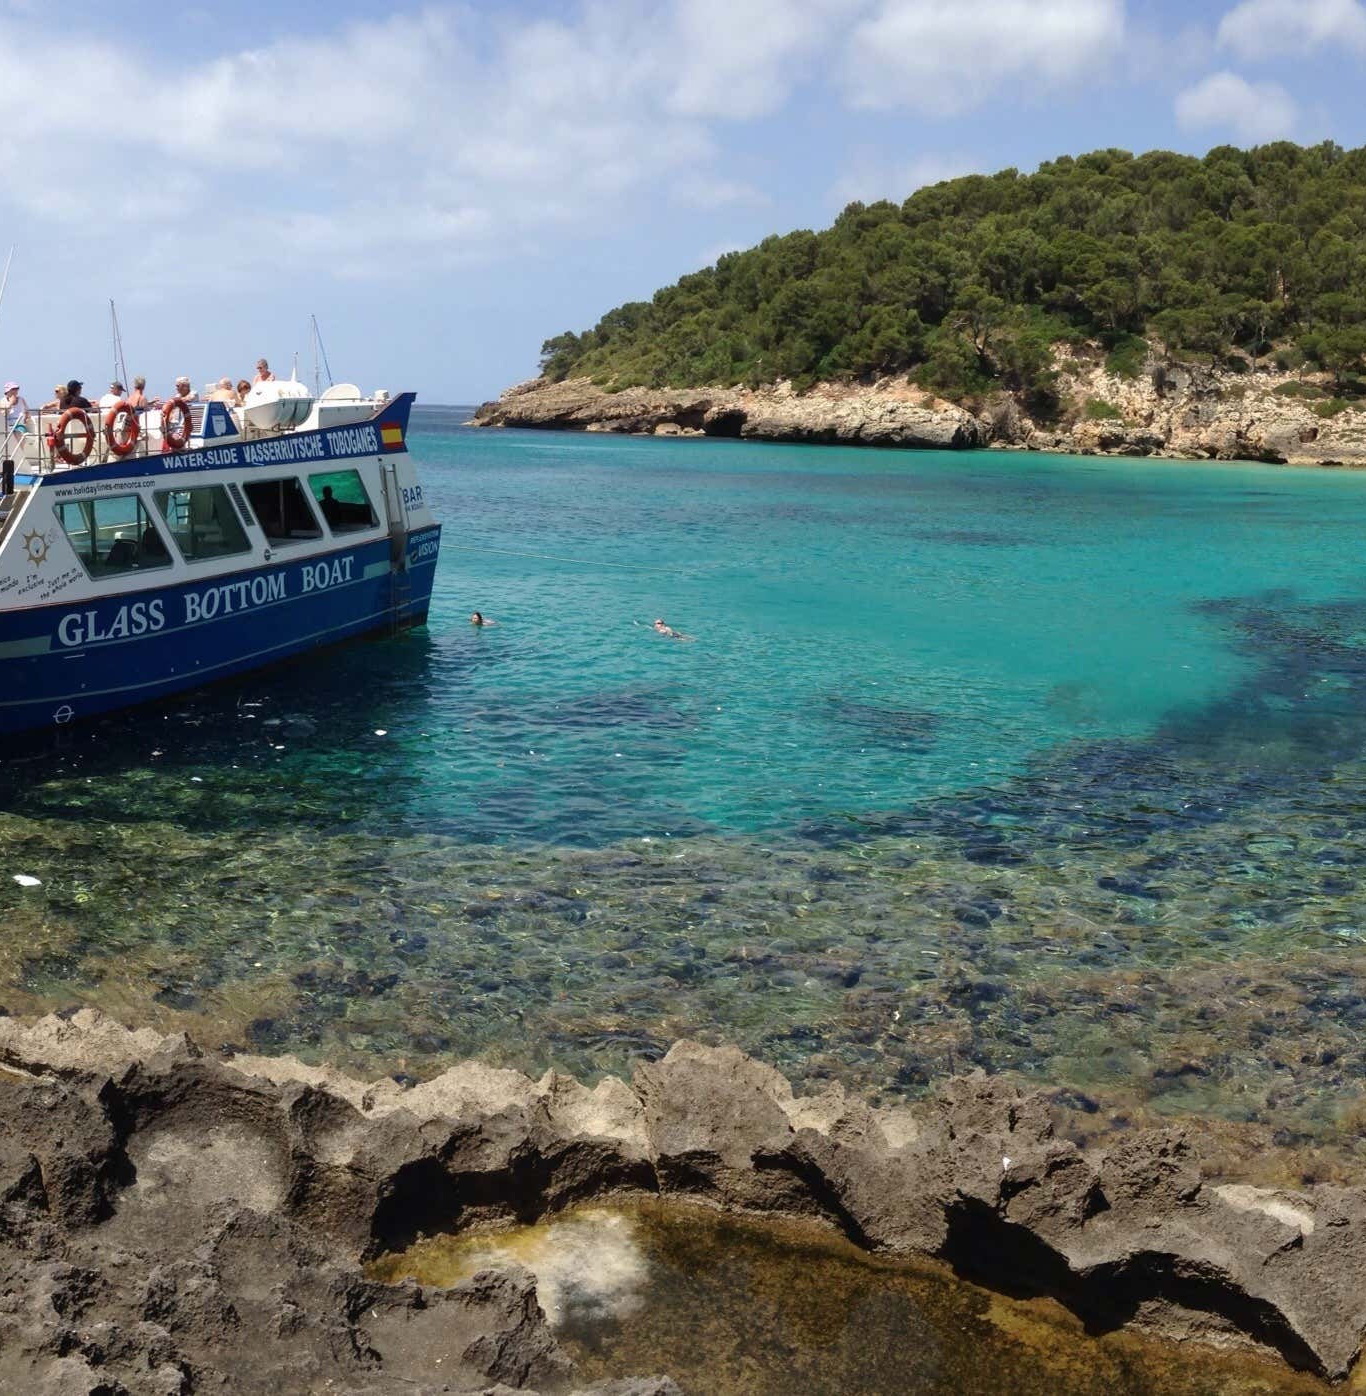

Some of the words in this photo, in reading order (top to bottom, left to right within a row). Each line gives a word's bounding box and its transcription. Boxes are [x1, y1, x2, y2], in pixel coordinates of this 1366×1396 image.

[163, 448, 238, 469] WATER-SLIDE
[243, 434, 325, 462] WASSERRUTSCHE
[327, 426, 379, 456] TOBOGANES
[402, 485, 423, 504] BAR
[58, 600, 165, 647] GLASS
[184, 572, 287, 623] BOTTOM
[301, 556, 355, 593] BOAT
